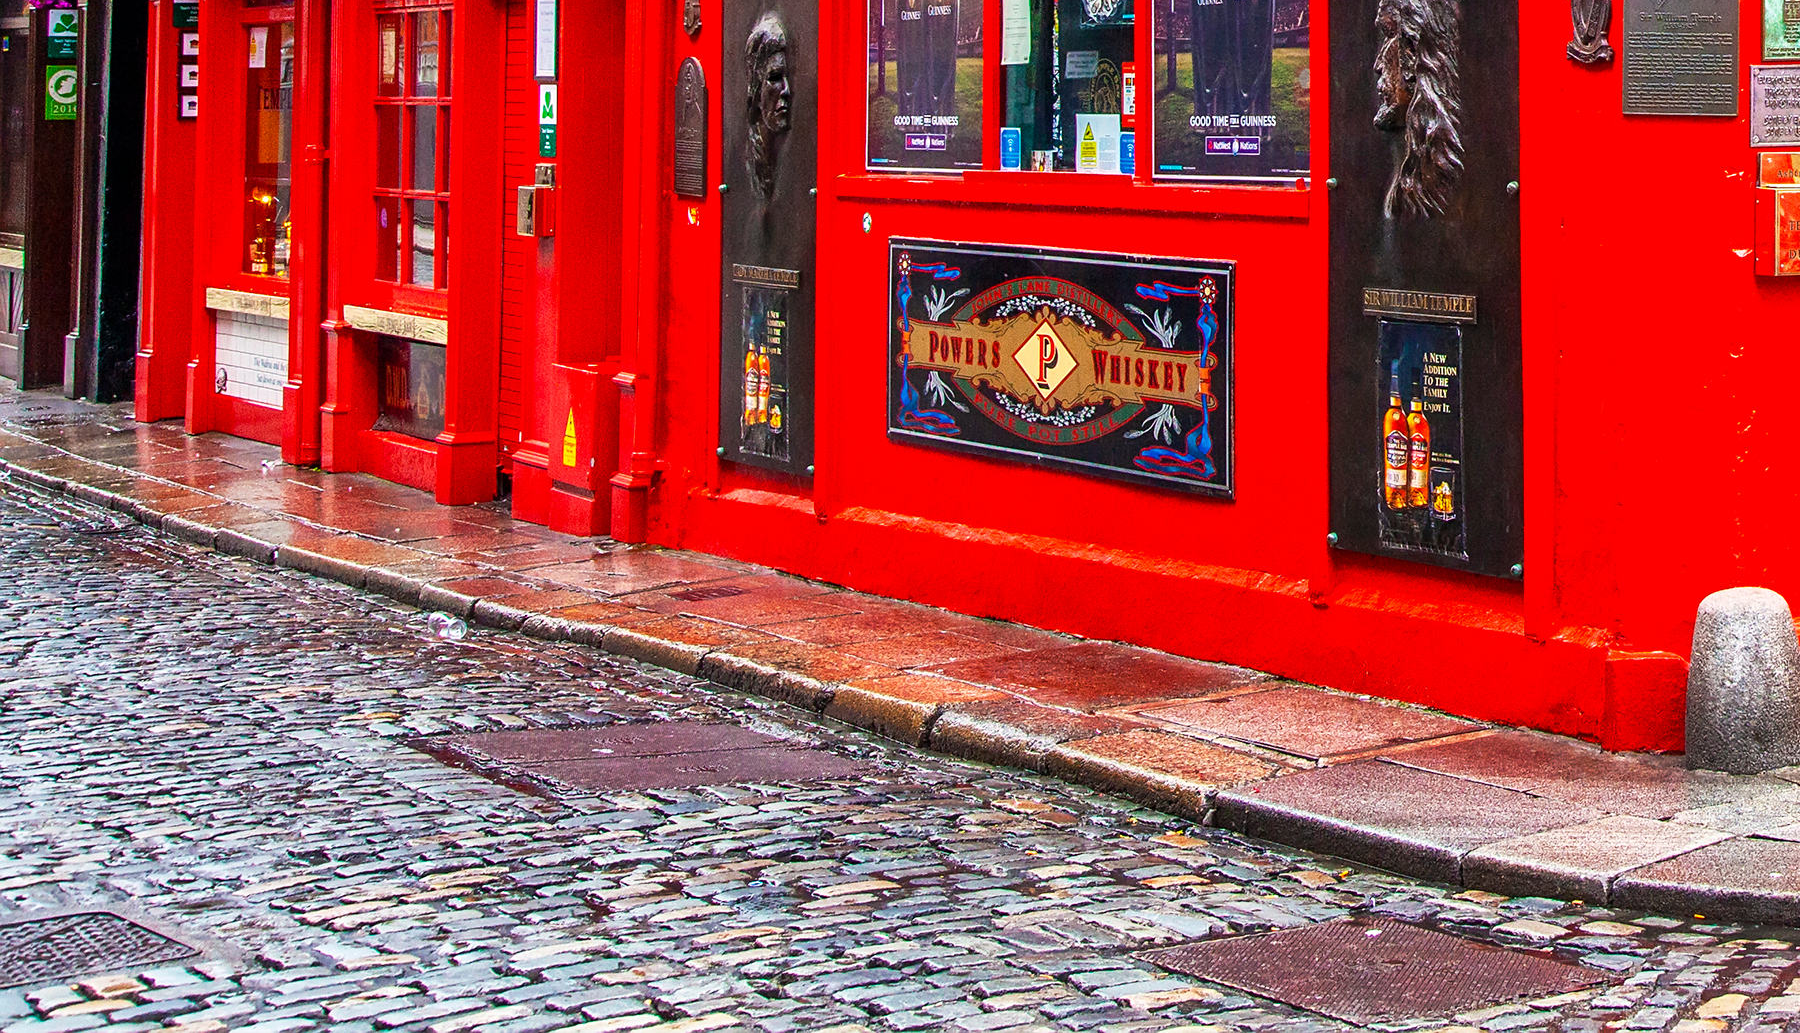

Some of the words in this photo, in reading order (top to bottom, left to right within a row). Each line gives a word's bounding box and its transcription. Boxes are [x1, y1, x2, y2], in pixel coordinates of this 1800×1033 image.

[928, 5, 952, 16] GUINNESS
[1691, 12, 1722, 24] Temple
[894, 116, 910, 125] GOOD
[1190, 116, 1211, 126] GOOD
[1212, 116, 1229, 126] TIME
[1240, 116, 1276, 126] GUINNESS
[971, 285, 1013, 313] JOHN'S
[1018, 281, 1050, 294] LANE
[1057, 282, 1123, 329] DISTILLERY
[1364, 290, 1381, 306] SIR
[1381, 291, 1427, 310] WILLIAM
[1427, 295, 1473, 313] TEMPLE
[929, 330, 1001, 369] POWERS
[1092, 349, 1188, 393] WHISKEY
[1036, 333, 1058, 389] P
[1422, 352, 1428, 363] A
[1430, 353, 1447, 364] NEW
[1423, 364, 1457, 376] ADDITION
[1423, 375, 1433, 386] TO
[1435, 377, 1449, 387] THE
[1423, 386, 1447, 398] FAMILY
[1423, 402, 1441, 413] ENJOY
[974, 393, 1015, 429] PURE
[1028, 426, 1060, 442] POT
[1072, 415, 1118, 442] STILL
